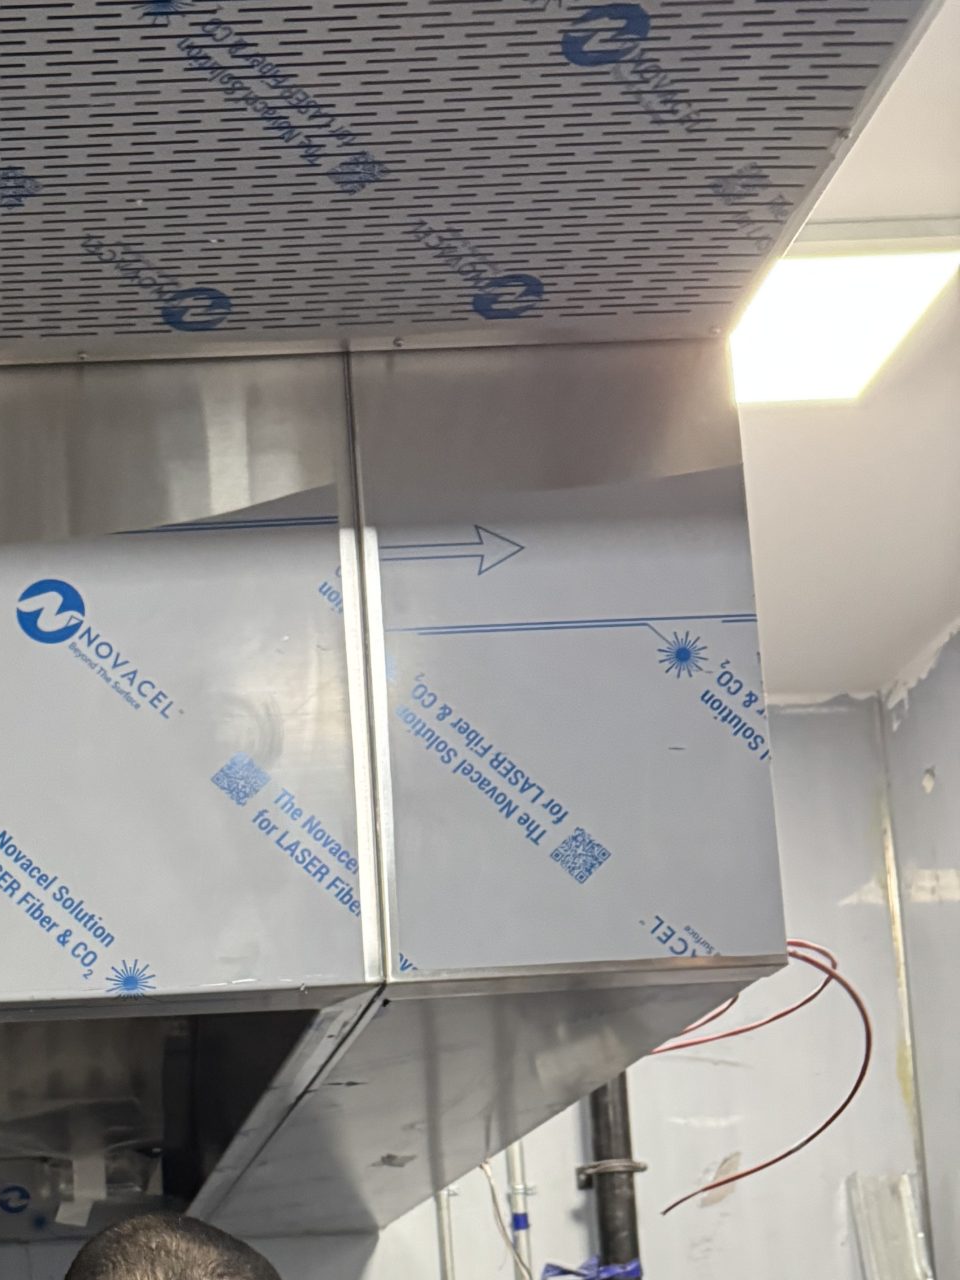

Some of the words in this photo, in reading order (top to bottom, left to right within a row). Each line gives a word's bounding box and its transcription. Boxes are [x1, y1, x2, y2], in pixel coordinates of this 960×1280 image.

[78, 626, 174, 720] NOVACEL
[742, 690, 759, 708] &
[436, 704, 453, 722] &
[449, 717, 493, 759] Fiber
[700, 689, 765, 751] Solution
[273, 787, 304, 821] The
[452, 759, 520, 820] Novacel
[489, 751, 546, 804] LASER
[516, 812, 548, 846] The
[541, 798, 570, 826] for
[251, 809, 279, 836] for
[275, 830, 330, 883] LASER
[16, 891, 60, 933] Fiber
[56, 928, 73, 947] &
[52, 884, 116, 949] Solution
